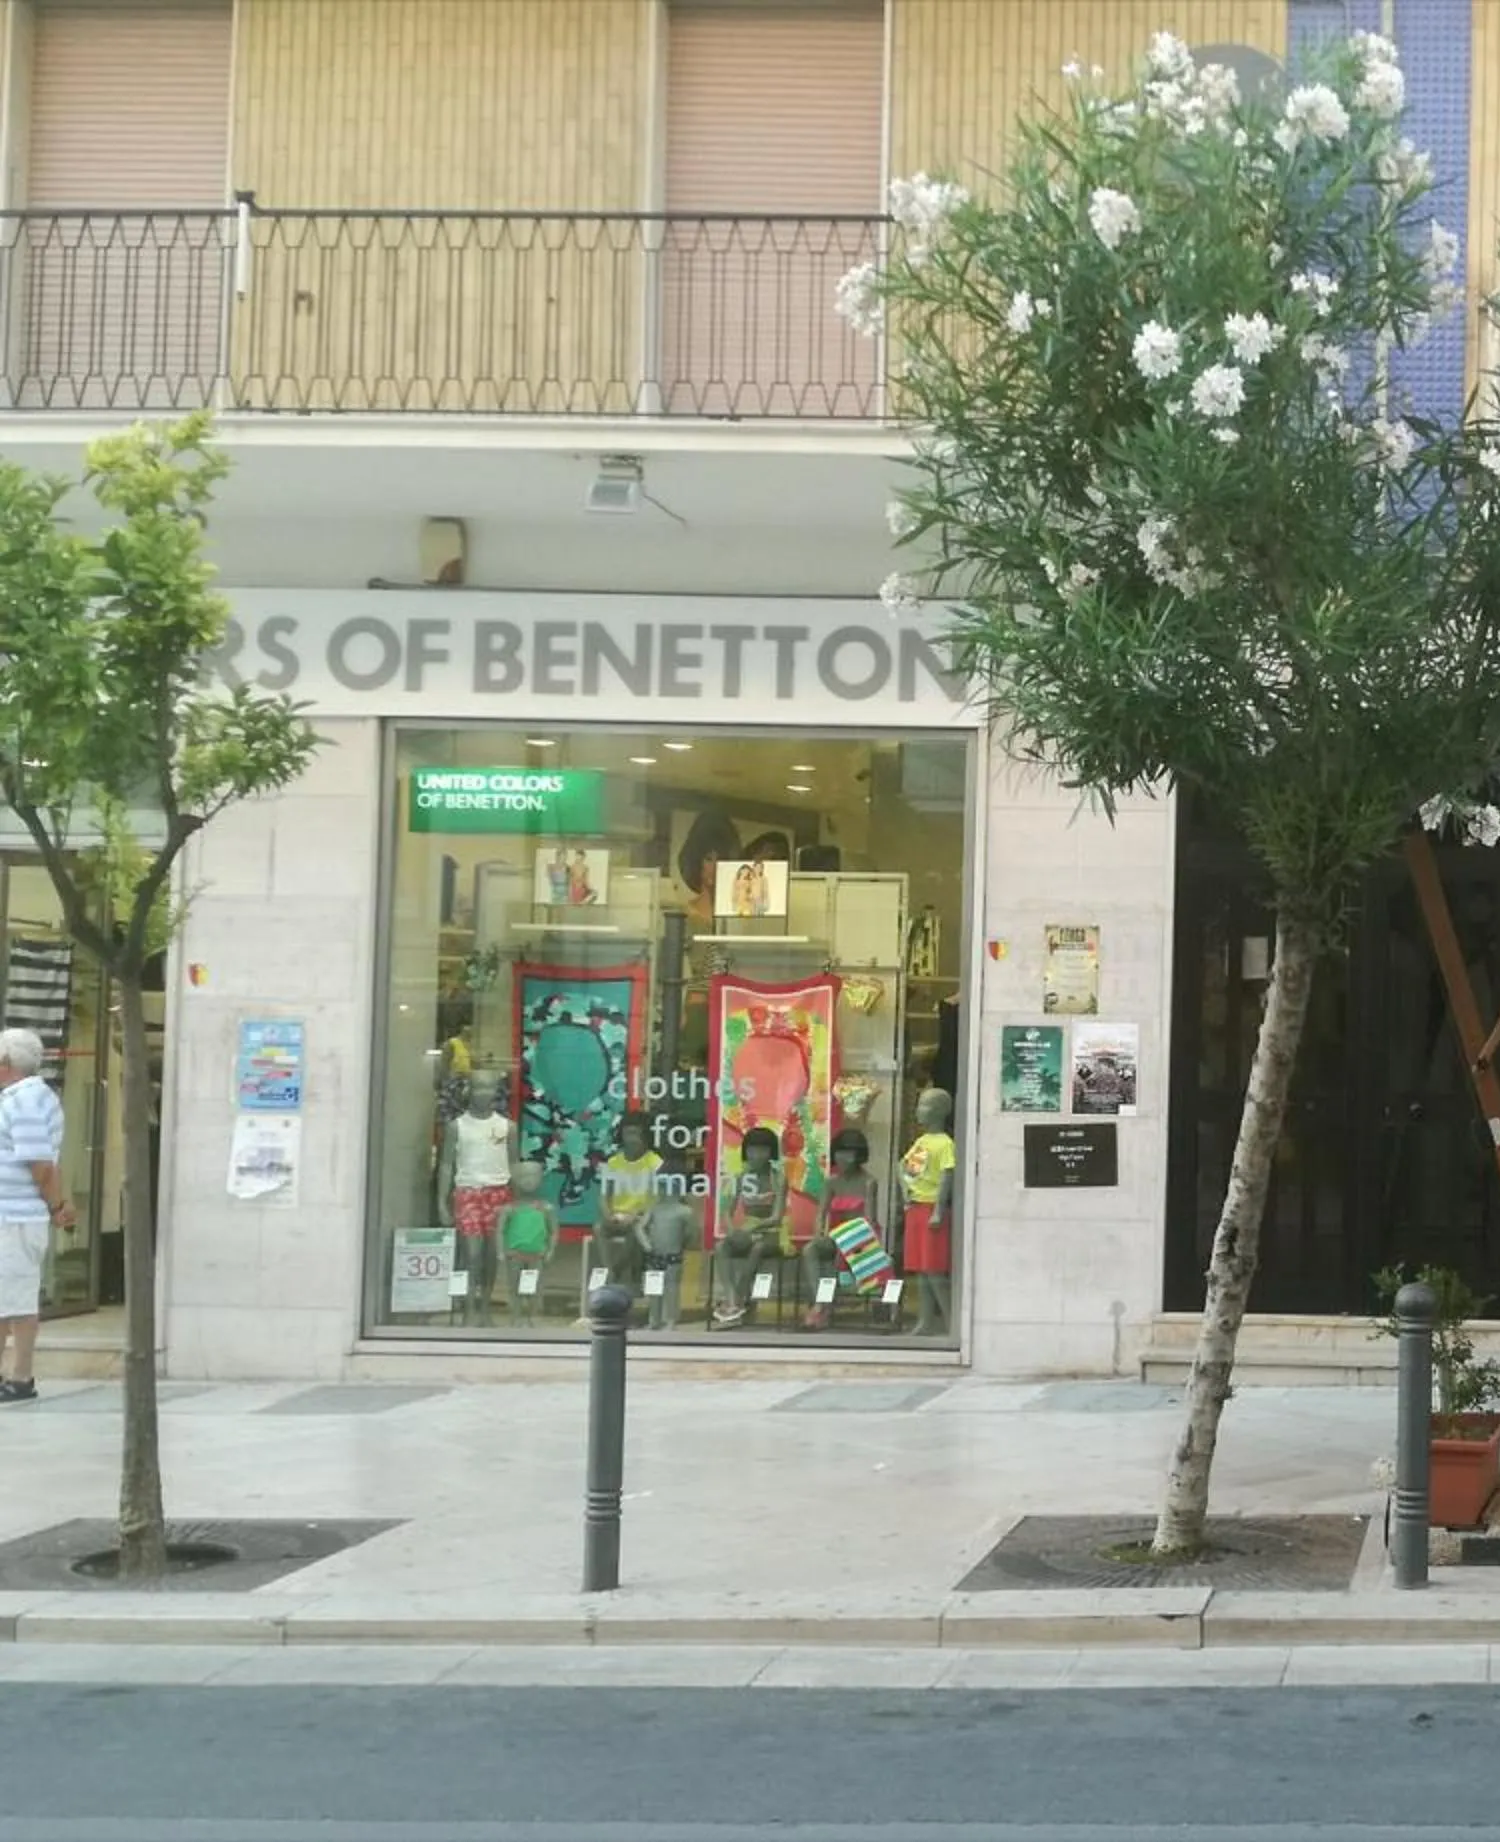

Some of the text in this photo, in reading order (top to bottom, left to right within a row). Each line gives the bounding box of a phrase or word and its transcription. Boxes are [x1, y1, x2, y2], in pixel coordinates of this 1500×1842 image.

[326, 616, 452, 692] OF
[472, 619, 966, 703] BENETTON
[417, 774, 564, 792] UNITED COLORS
[417, 793, 547, 811] OF BENETTON.
[607, 1066, 757, 1101] clothes
[650, 1113, 712, 1149] for
[600, 1162, 760, 1199] humans
